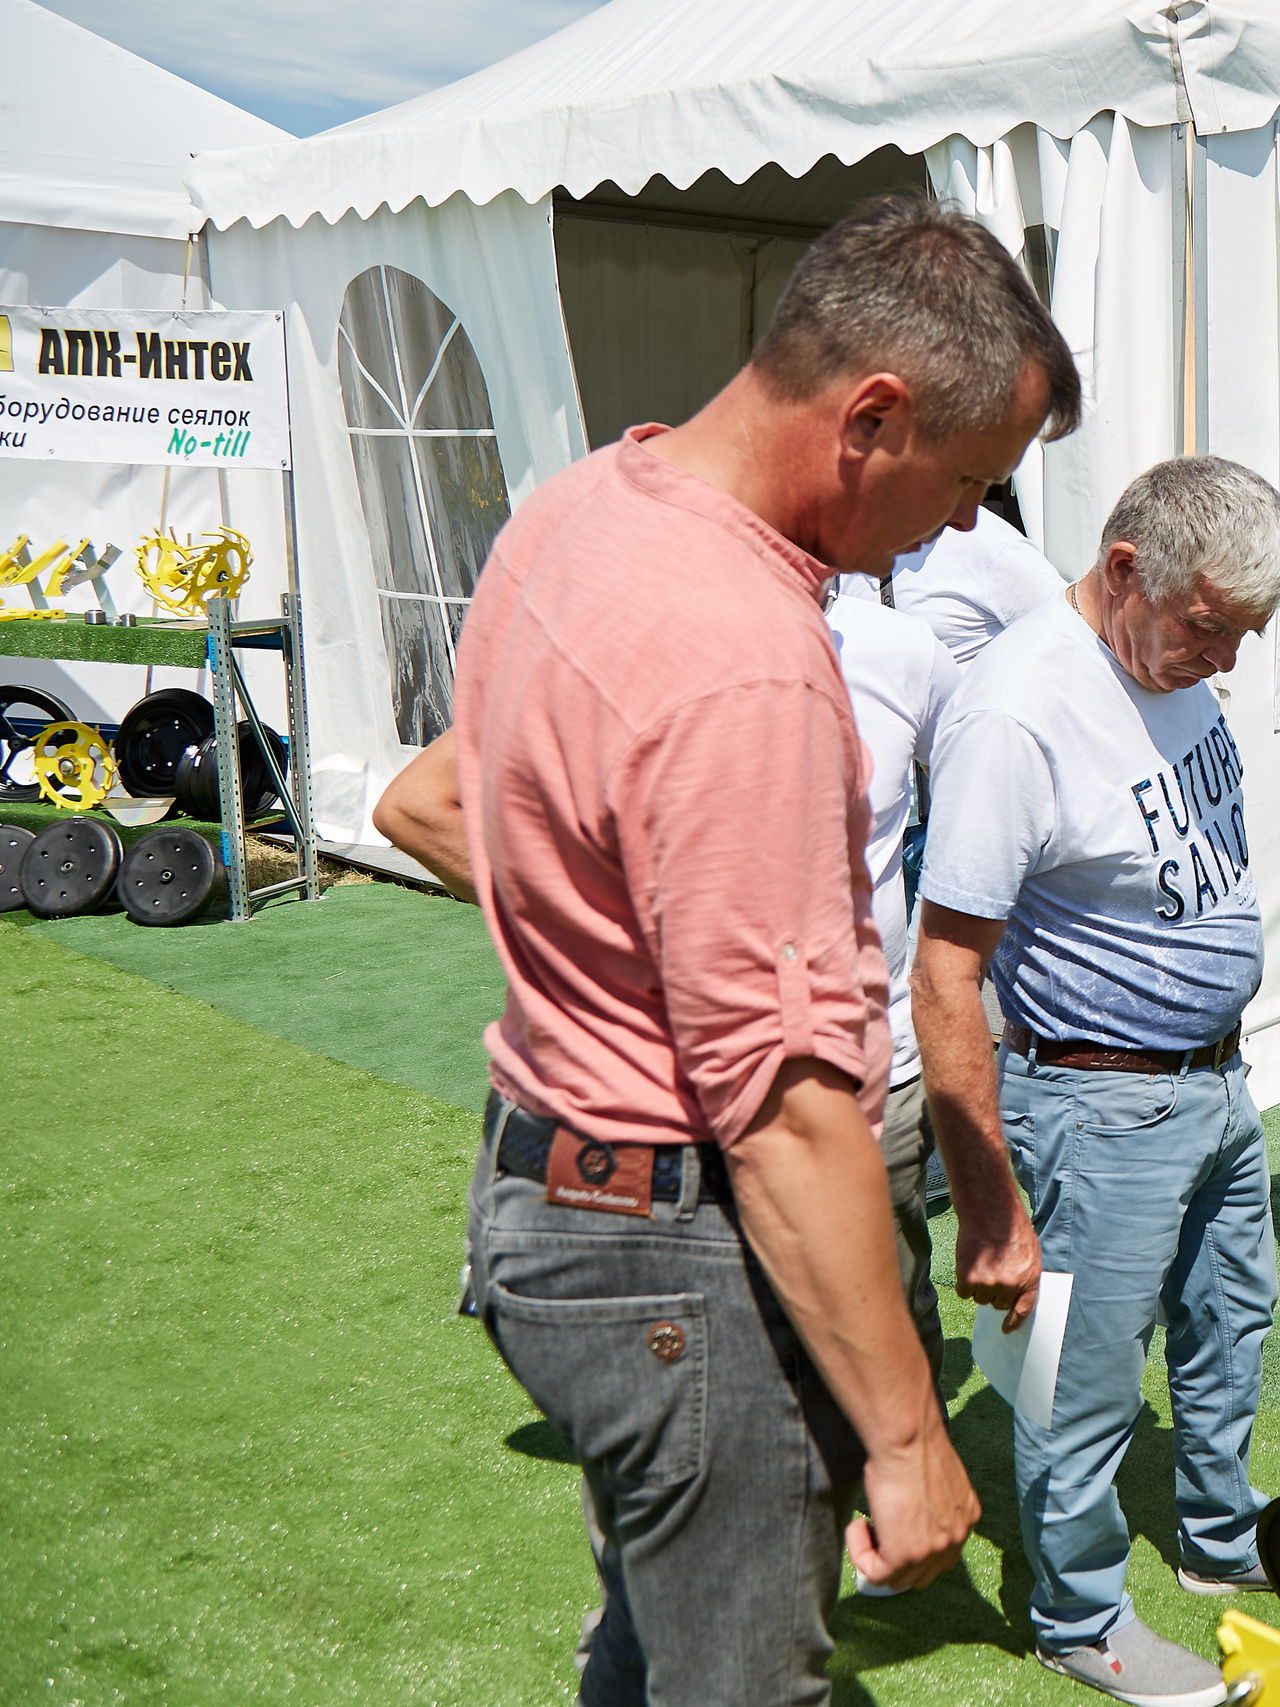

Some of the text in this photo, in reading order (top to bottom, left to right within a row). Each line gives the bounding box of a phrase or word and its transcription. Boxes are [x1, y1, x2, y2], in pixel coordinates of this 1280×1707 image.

[38, 327, 254, 382] АПК-Интех
[167, 407, 250, 427] сеялок
[167, 428, 251, 457] No-till
[1130, 713, 1244, 855] FUTURE
